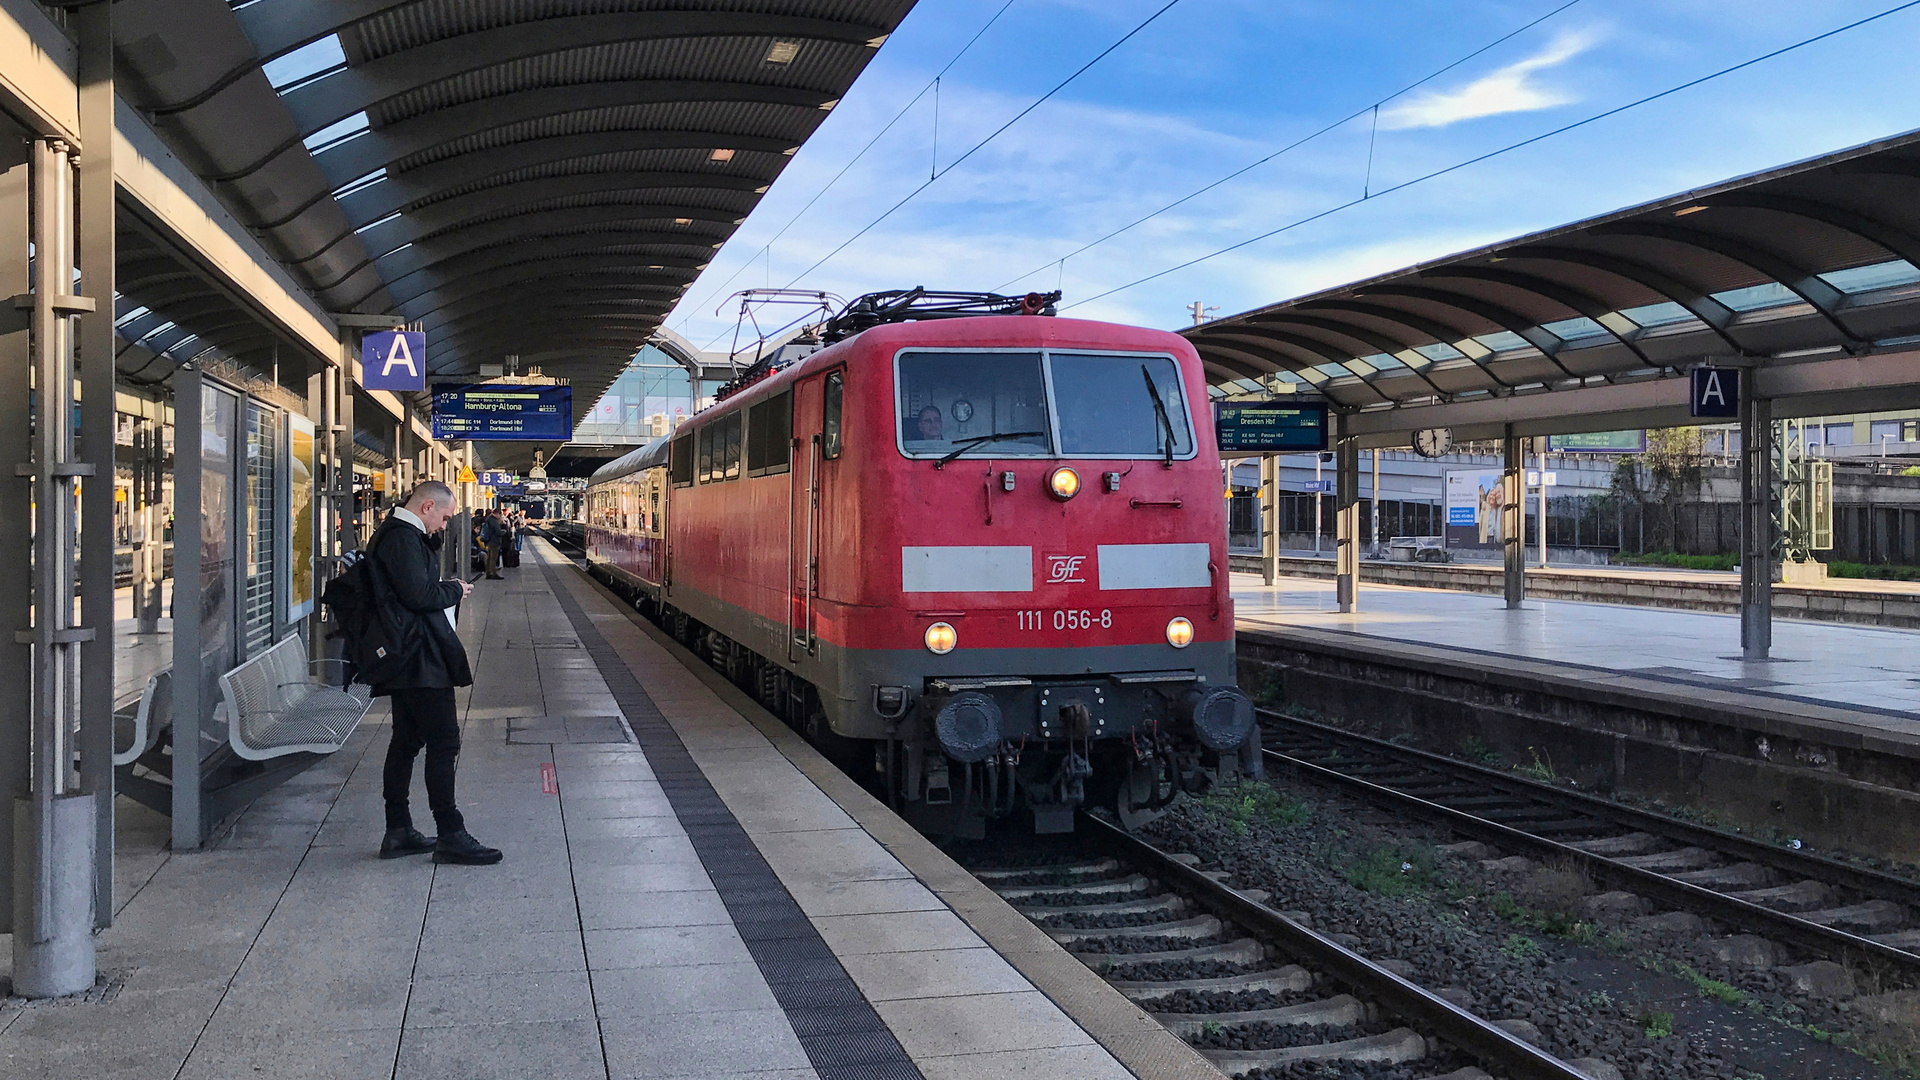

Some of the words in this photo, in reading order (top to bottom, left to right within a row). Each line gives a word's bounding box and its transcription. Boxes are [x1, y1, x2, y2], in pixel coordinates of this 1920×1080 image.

[381, 334, 418, 377] A
[1701, 371, 1725, 406] A
[465, 402, 522, 411] Hamburg-Altona
[1265, 417, 1276, 425] Hbf
[482, 473, 491, 483] B
[496, 472, 512, 484] 3b
[1017, 610, 1042, 630] 111
[1053, 609, 1112, 630] 056-8
